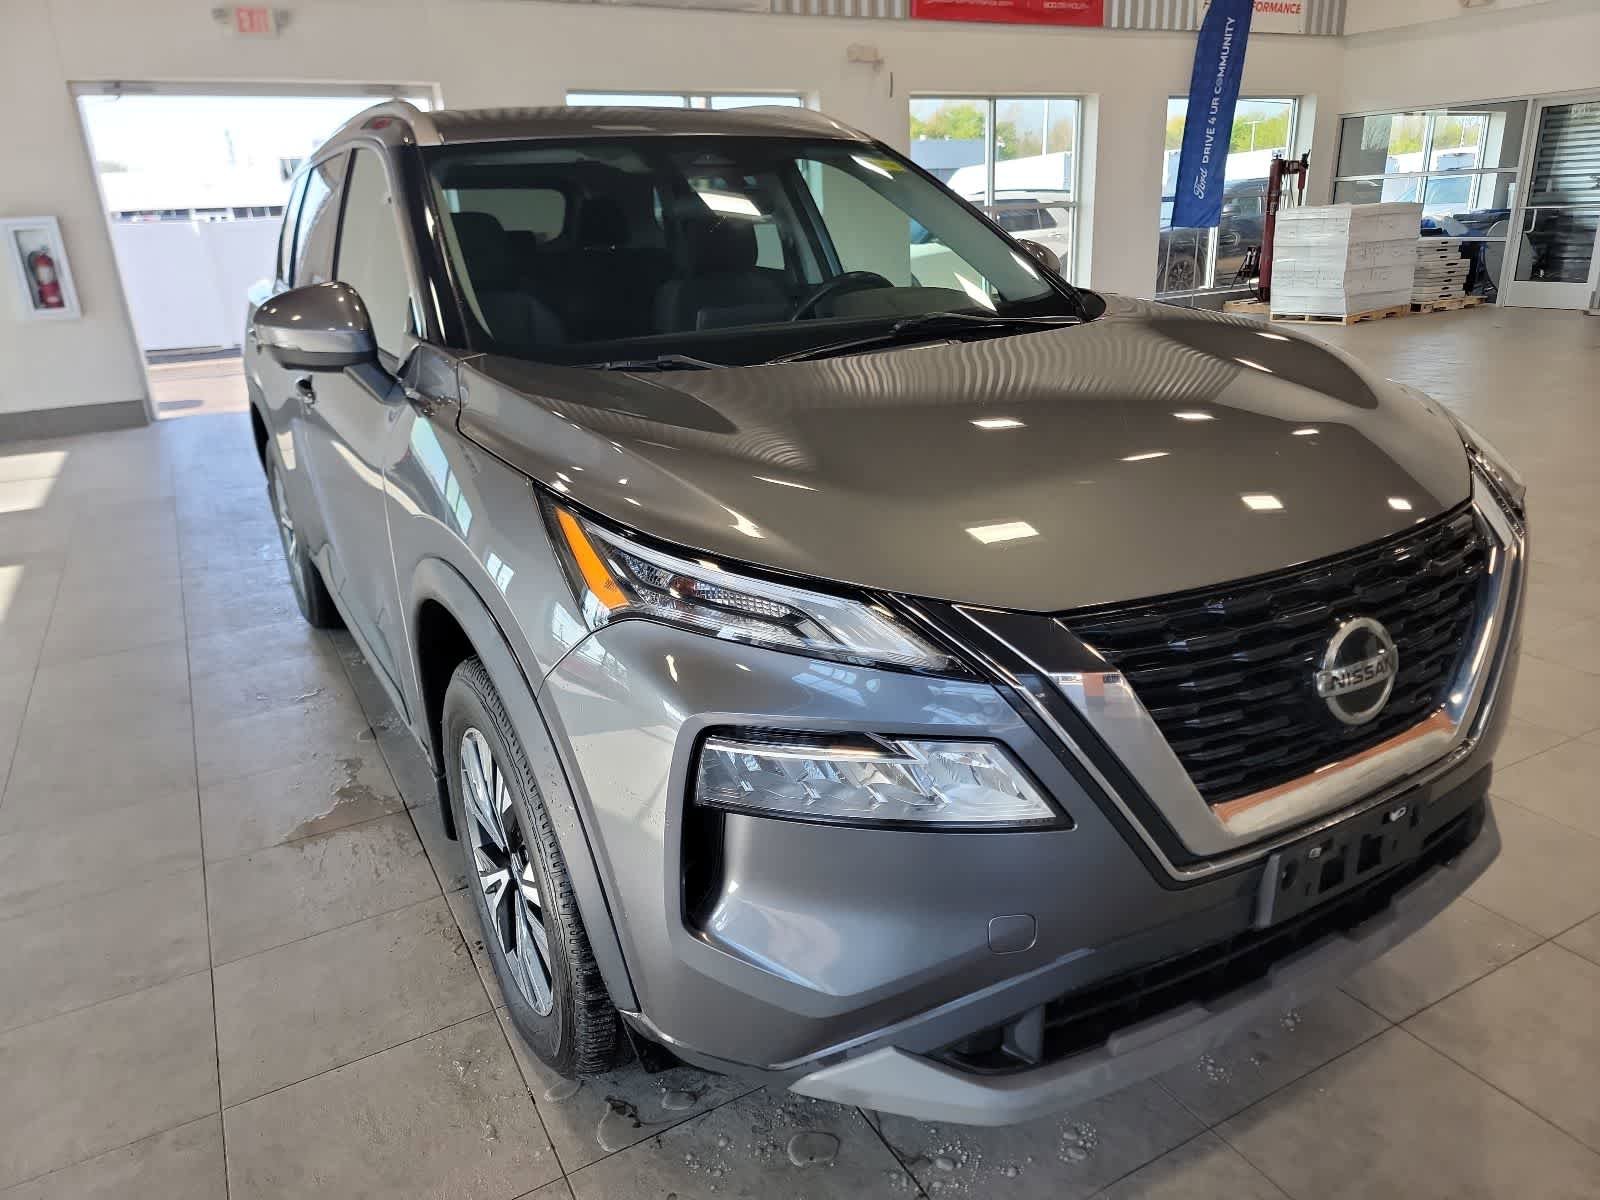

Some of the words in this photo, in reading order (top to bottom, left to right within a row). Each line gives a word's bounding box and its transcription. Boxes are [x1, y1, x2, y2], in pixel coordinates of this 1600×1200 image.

[1252, 2, 1302, 14] FORMANCE
[1214, 17, 1236, 95] COMMUNITY
[1208, 117, 1217, 125] 4
[1210, 97, 1221, 115] UR
[1202, 128, 1216, 163] DRIVE
[1193, 167, 1207, 199] Ford
[1329, 657, 1391, 689] NISSAN
